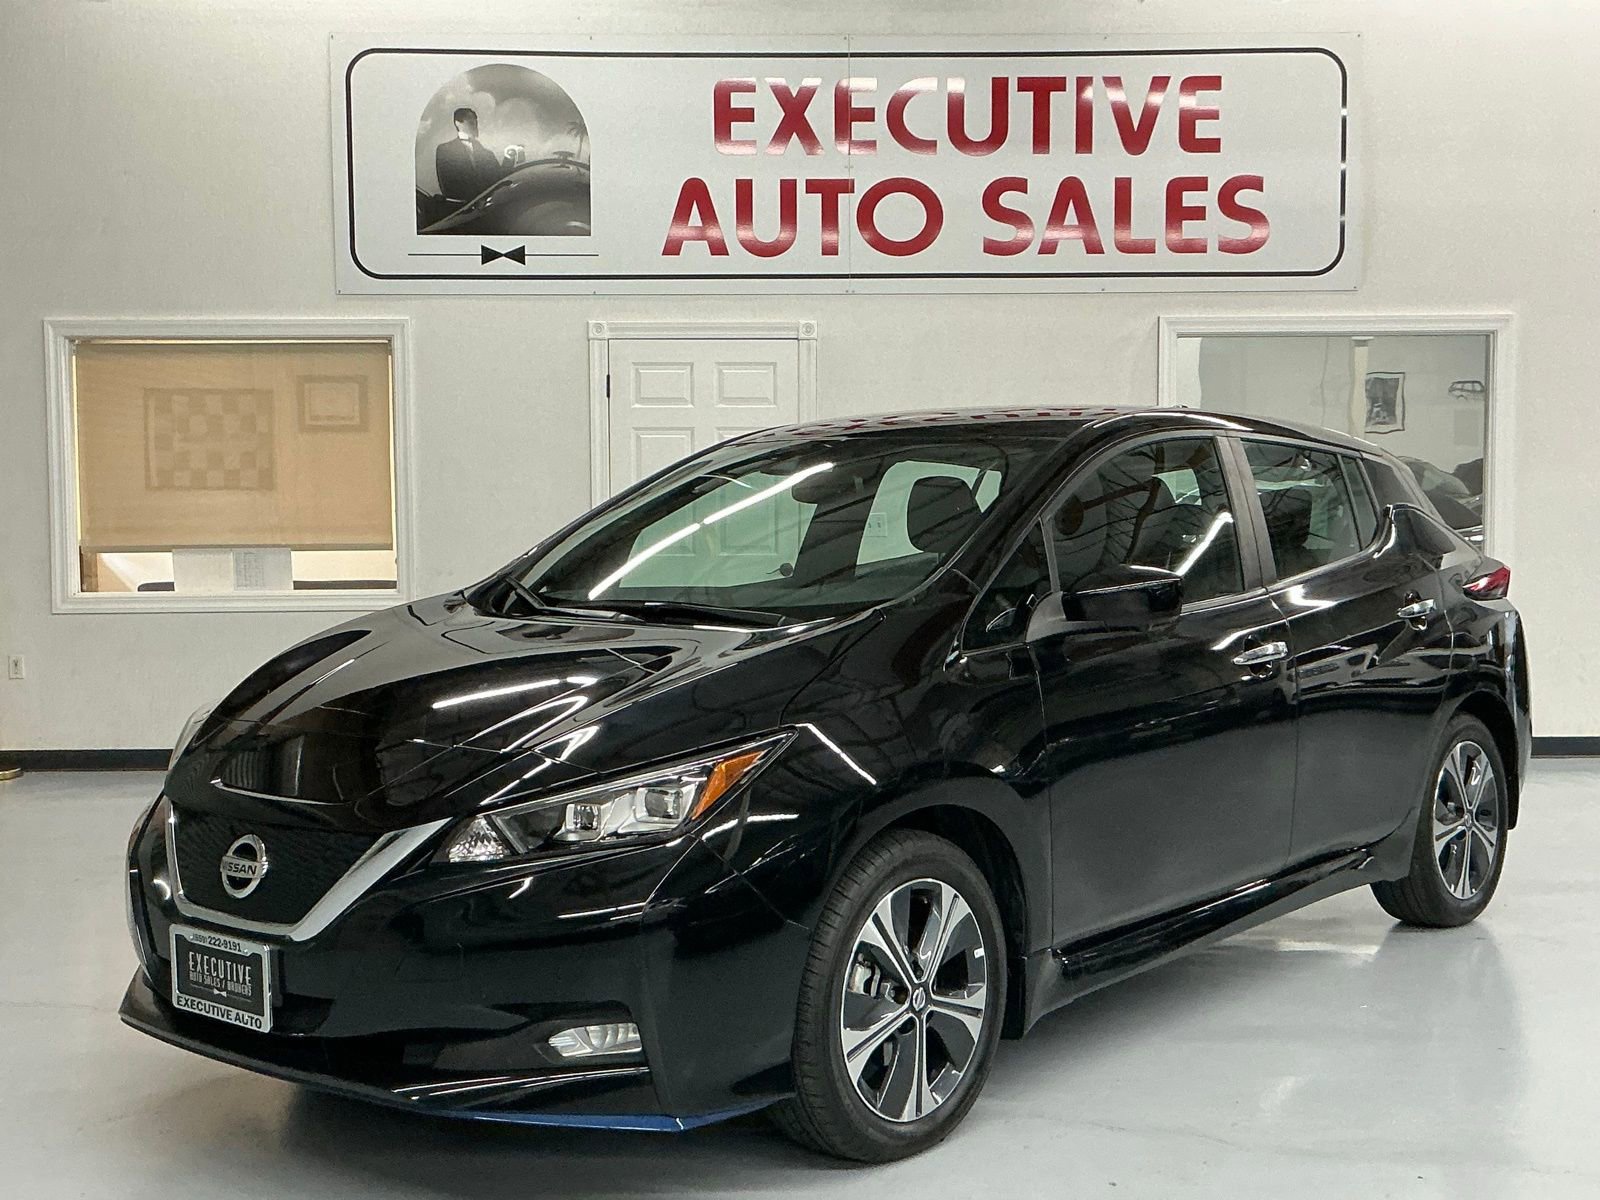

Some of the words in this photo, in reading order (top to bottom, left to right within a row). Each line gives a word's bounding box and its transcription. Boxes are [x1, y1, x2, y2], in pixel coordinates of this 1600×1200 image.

[713, 76, 1223, 156] EXECUTIVE
[662, 176, 943, 258] AUTO
[982, 174, 1270, 257] SALES
[208, 936, 242, 952] 222-9191
[189, 951, 251, 986] EXECUTIVE
[177, 995, 233, 1021] EXECUTIVE
[234, 1012, 262, 1029] AUTO
